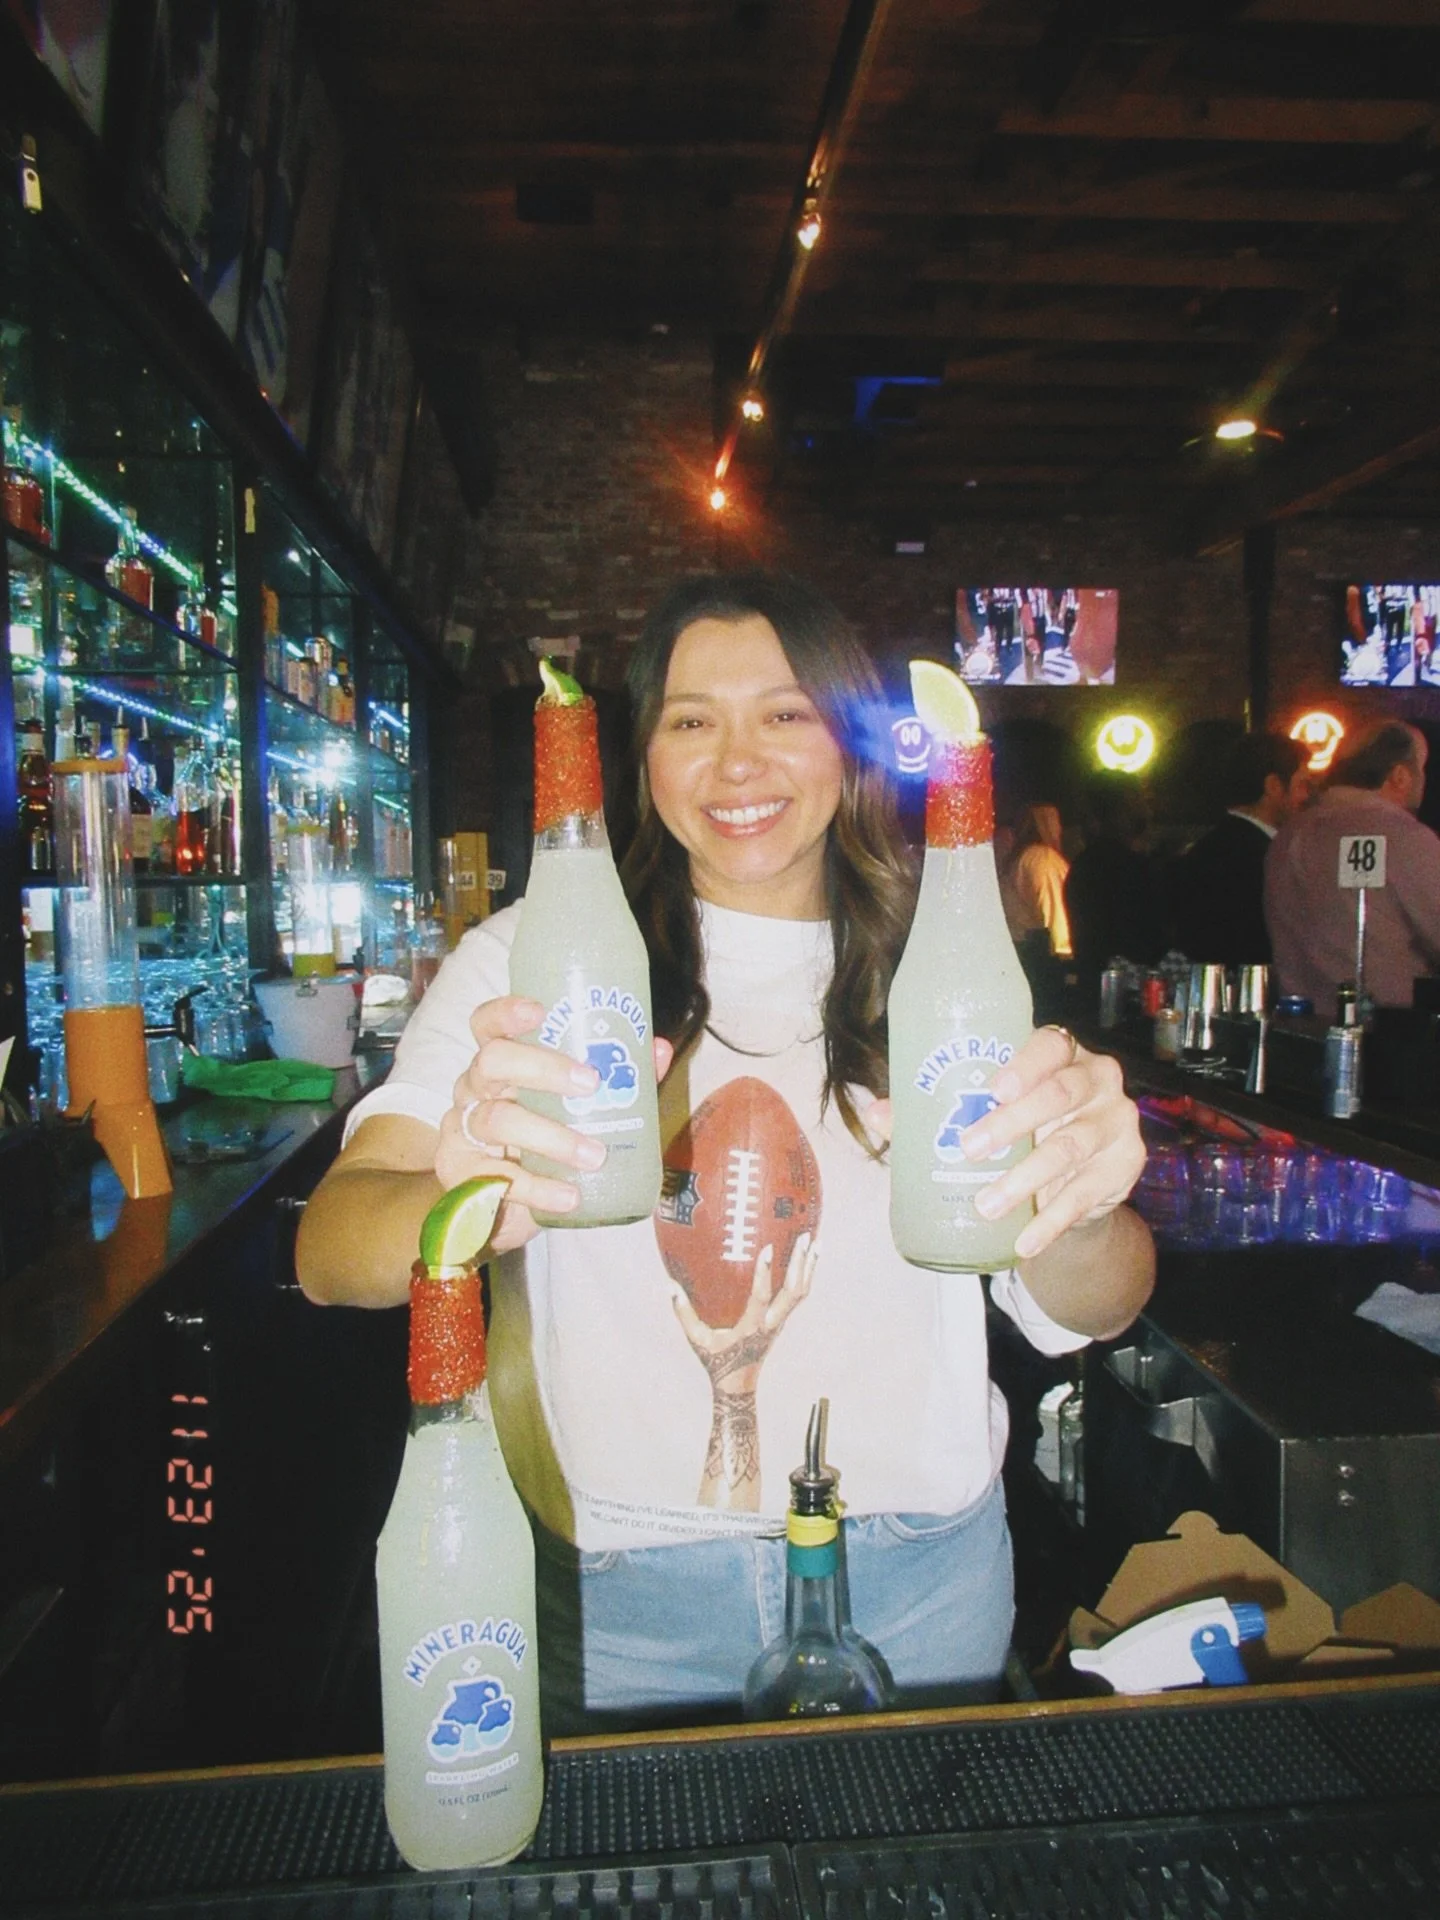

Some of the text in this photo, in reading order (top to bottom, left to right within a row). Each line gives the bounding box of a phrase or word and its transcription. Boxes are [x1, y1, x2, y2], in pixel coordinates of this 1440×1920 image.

[1347, 839, 1376, 871] 48
[487, 872, 503, 888] 39
[541, 987, 648, 1047] MINRAGUA
[916, 1037, 1013, 1092] MINERAG
[631, 1518, 646, 1530] DO
[405, 1620, 526, 1684] MINERAGUA
